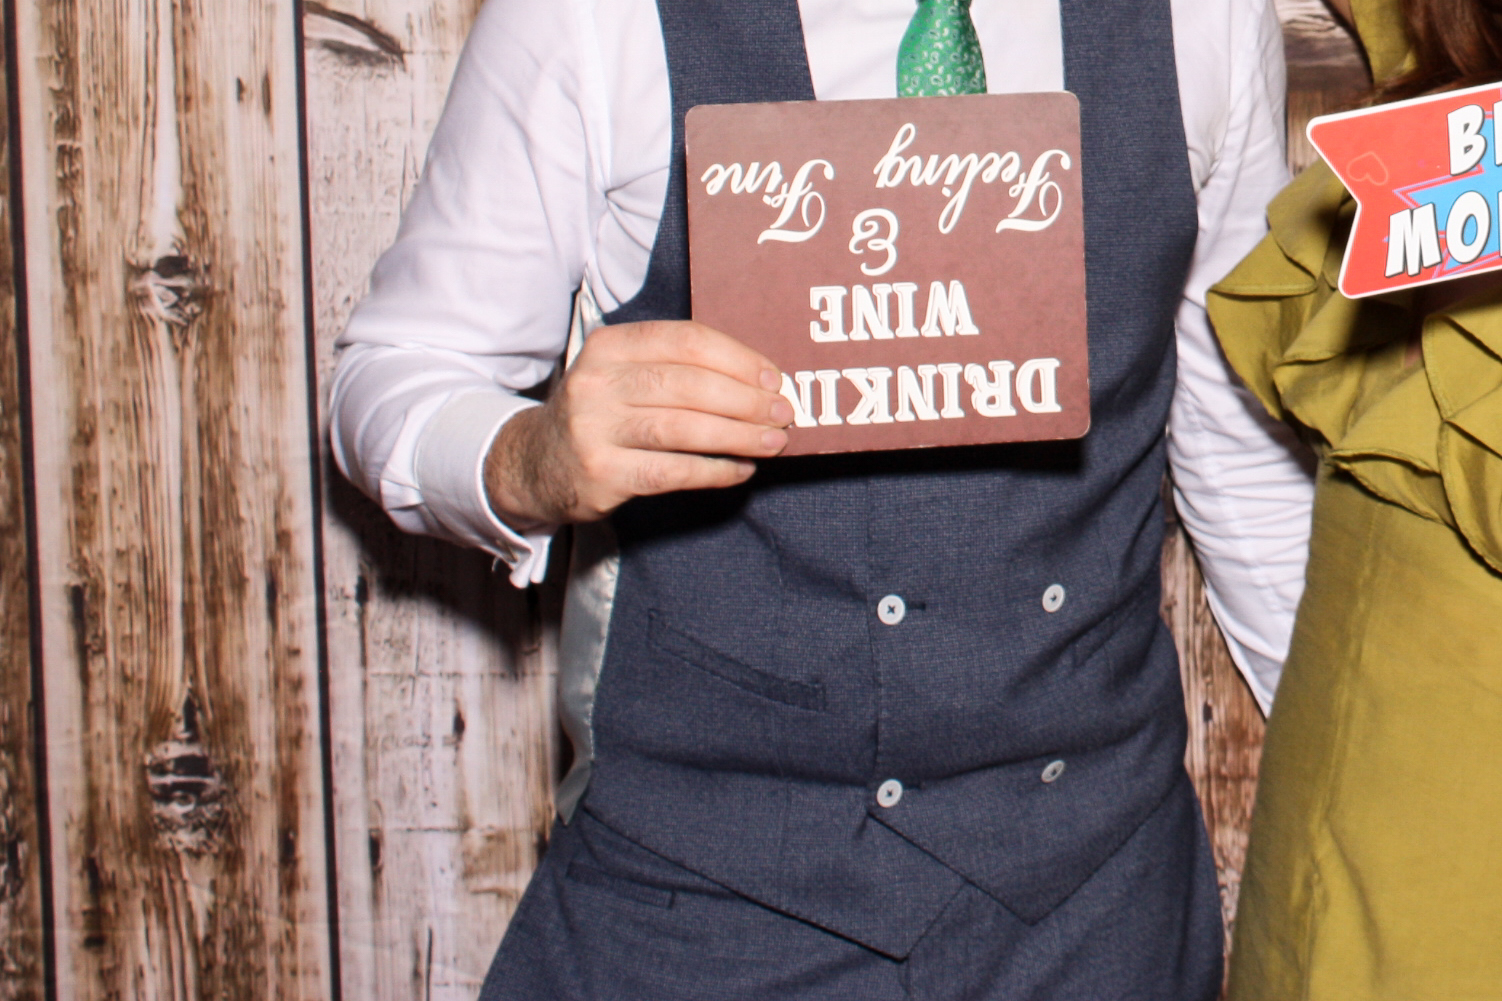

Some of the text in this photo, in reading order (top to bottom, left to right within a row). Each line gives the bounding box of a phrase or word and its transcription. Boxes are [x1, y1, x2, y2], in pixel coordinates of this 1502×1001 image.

[700, 122, 1072, 245] Feeling Fine
[848, 207, 899, 276] &
[809, 280, 980, 343] WINE
[779, 357, 1063, 428] DRINKIN
